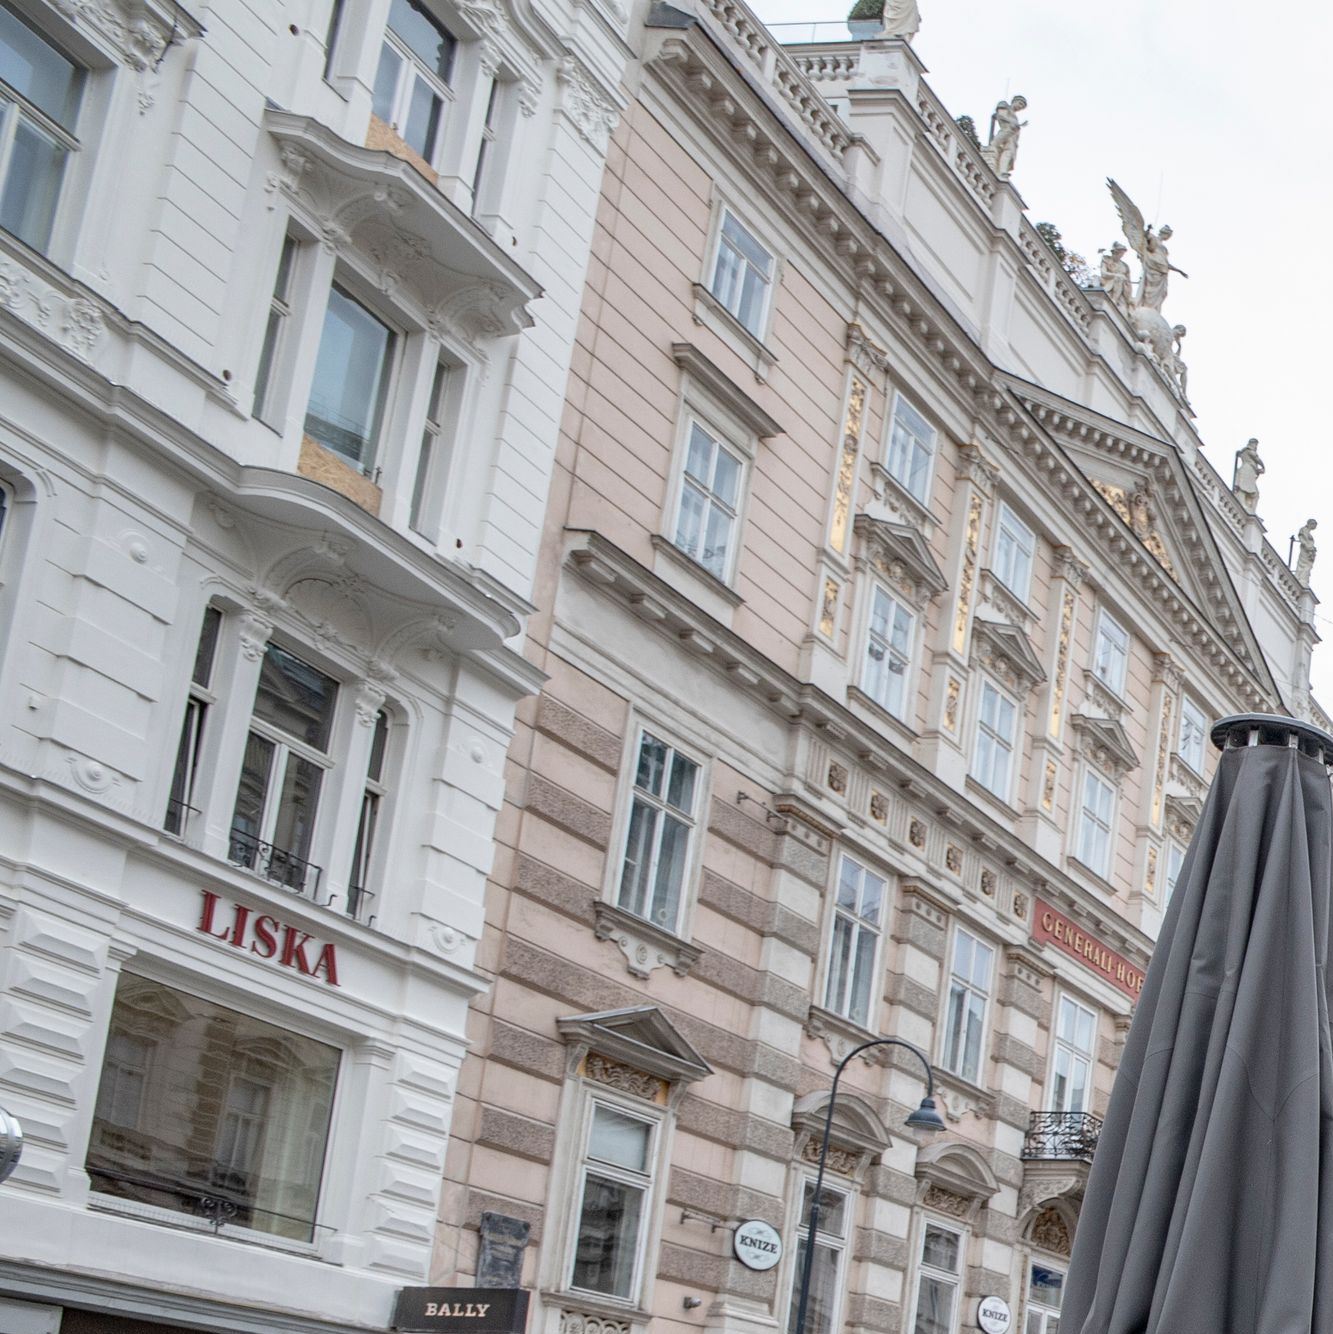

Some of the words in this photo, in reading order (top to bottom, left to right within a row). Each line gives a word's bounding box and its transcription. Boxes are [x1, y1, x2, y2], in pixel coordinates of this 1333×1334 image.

[195, 889, 341, 987] LISKA
[739, 1235, 779, 1255] KNIZE
[425, 1302, 491, 1319] BALLY
[981, 1307, 1009, 1322] KNIZE
